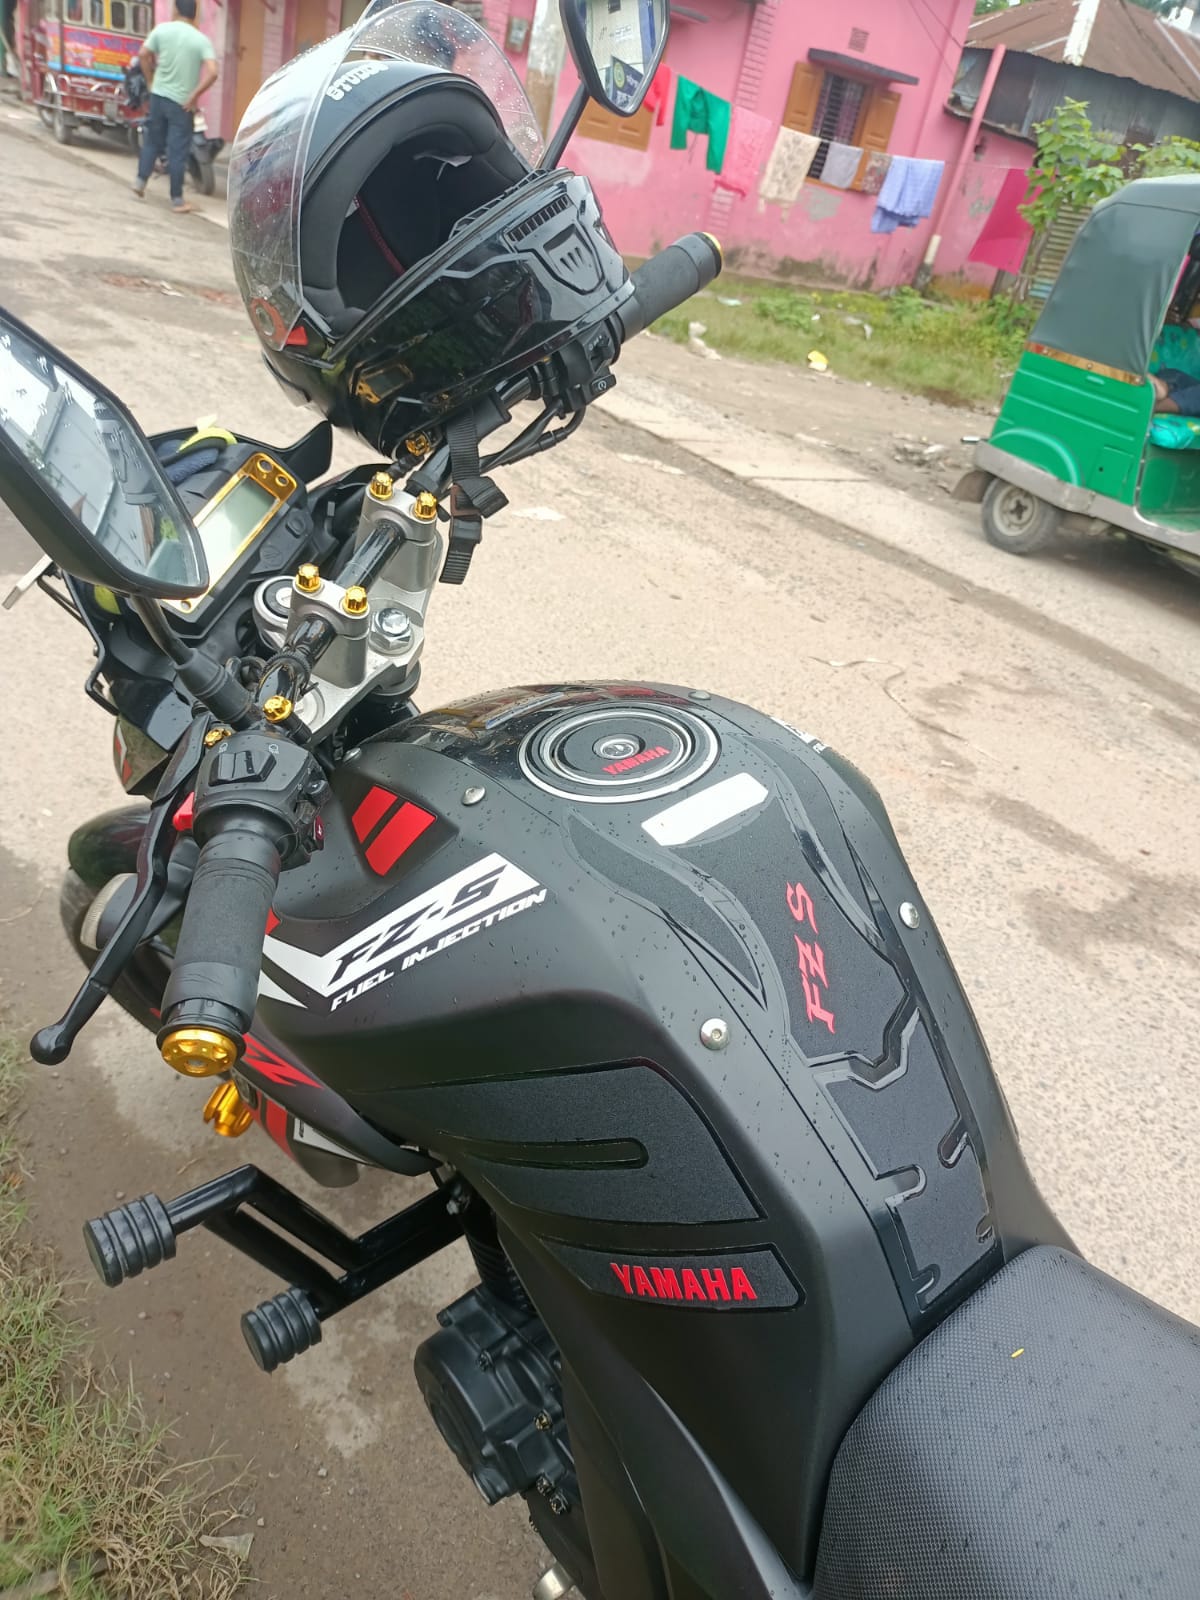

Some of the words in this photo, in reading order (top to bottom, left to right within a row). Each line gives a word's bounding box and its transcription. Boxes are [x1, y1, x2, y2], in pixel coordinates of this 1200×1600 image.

[601, 745, 672, 775] YAMAHA
[331, 969, 394, 1012] FUEL
[401, 888, 548, 971] INJECTION
[610, 1262, 758, 1301] YAMAHA
